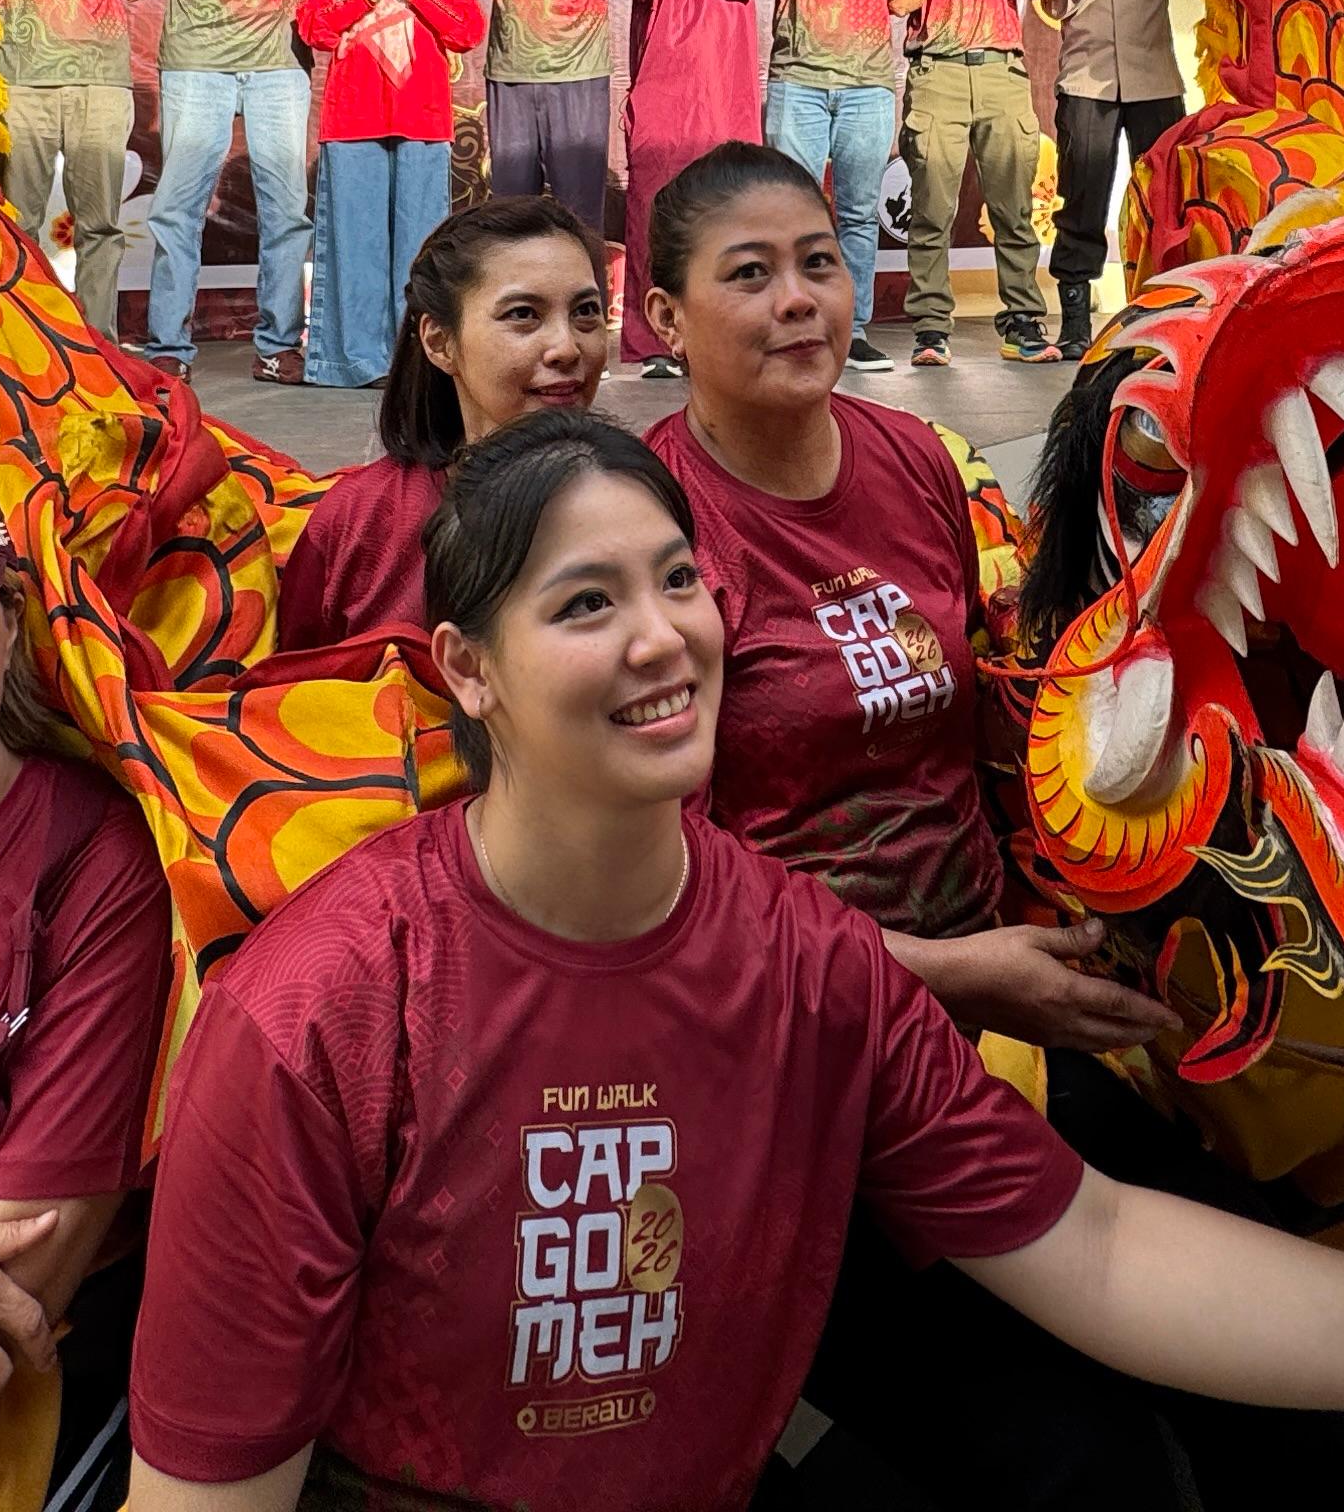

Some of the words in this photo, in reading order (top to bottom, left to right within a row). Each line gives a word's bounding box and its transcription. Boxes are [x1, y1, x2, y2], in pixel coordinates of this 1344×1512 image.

[811, 576, 847, 599] FUN
[815, 583, 912, 642] CAP
[905, 623, 928, 650] 20
[915, 638, 937, 665] 26
[840, 636, 911, 689] GO
[856, 666, 956, 735] MEH
[543, 1086, 589, 1113] FUN
[596, 1083, 658, 1111] WALK
[526, 1124, 674, 1209] CAP
[631, 1208, 677, 1245] 20
[520, 1210, 623, 1299] GO
[631, 1239, 678, 1277] 26
[510, 1290, 679, 1384] MEH
[543, 1398, 635, 1430] BERAU
